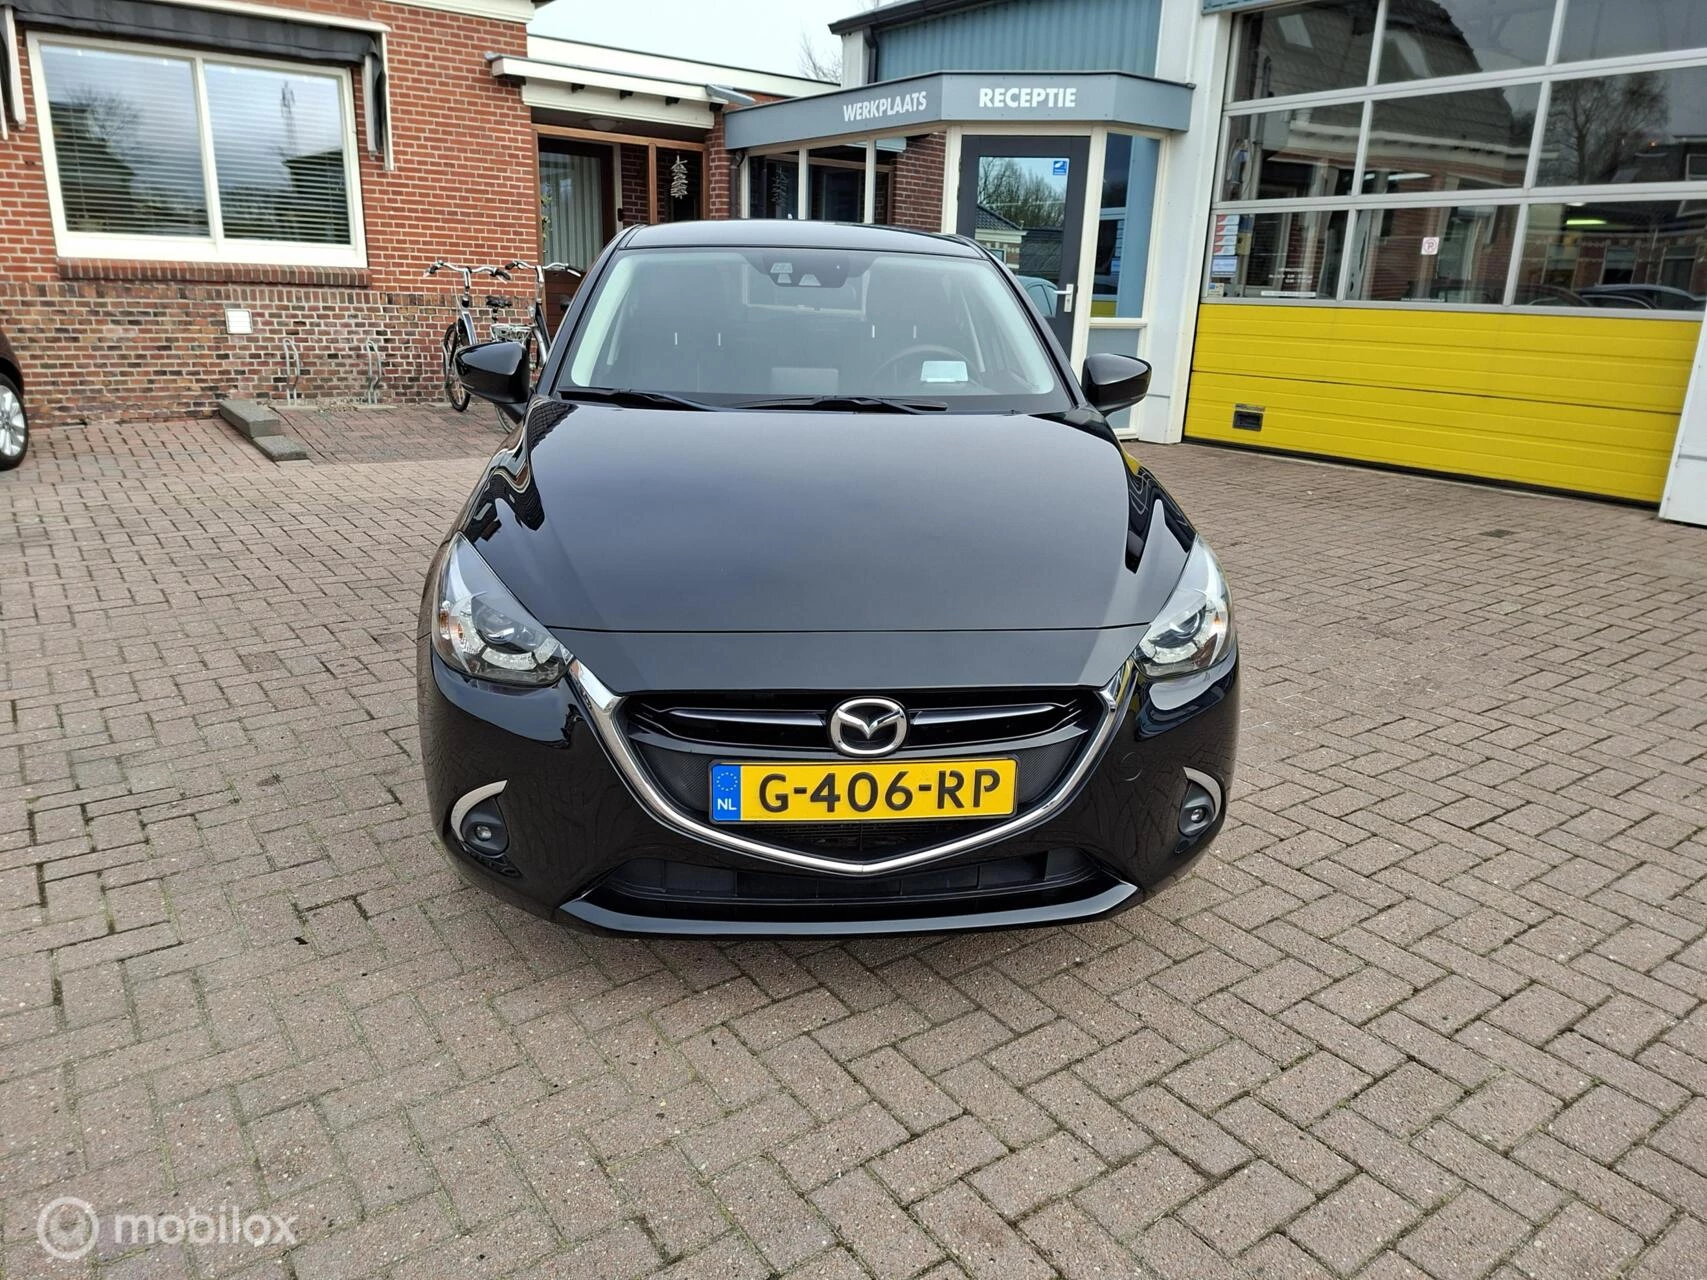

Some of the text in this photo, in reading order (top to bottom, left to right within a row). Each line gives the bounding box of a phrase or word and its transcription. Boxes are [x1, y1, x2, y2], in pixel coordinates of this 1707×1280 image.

[843, 91, 928, 122] WERKPLAATS
[979, 87, 1077, 108] RECEPTIE
[758, 768, 1000, 813] G-406-RP
[717, 798, 737, 811] NL
